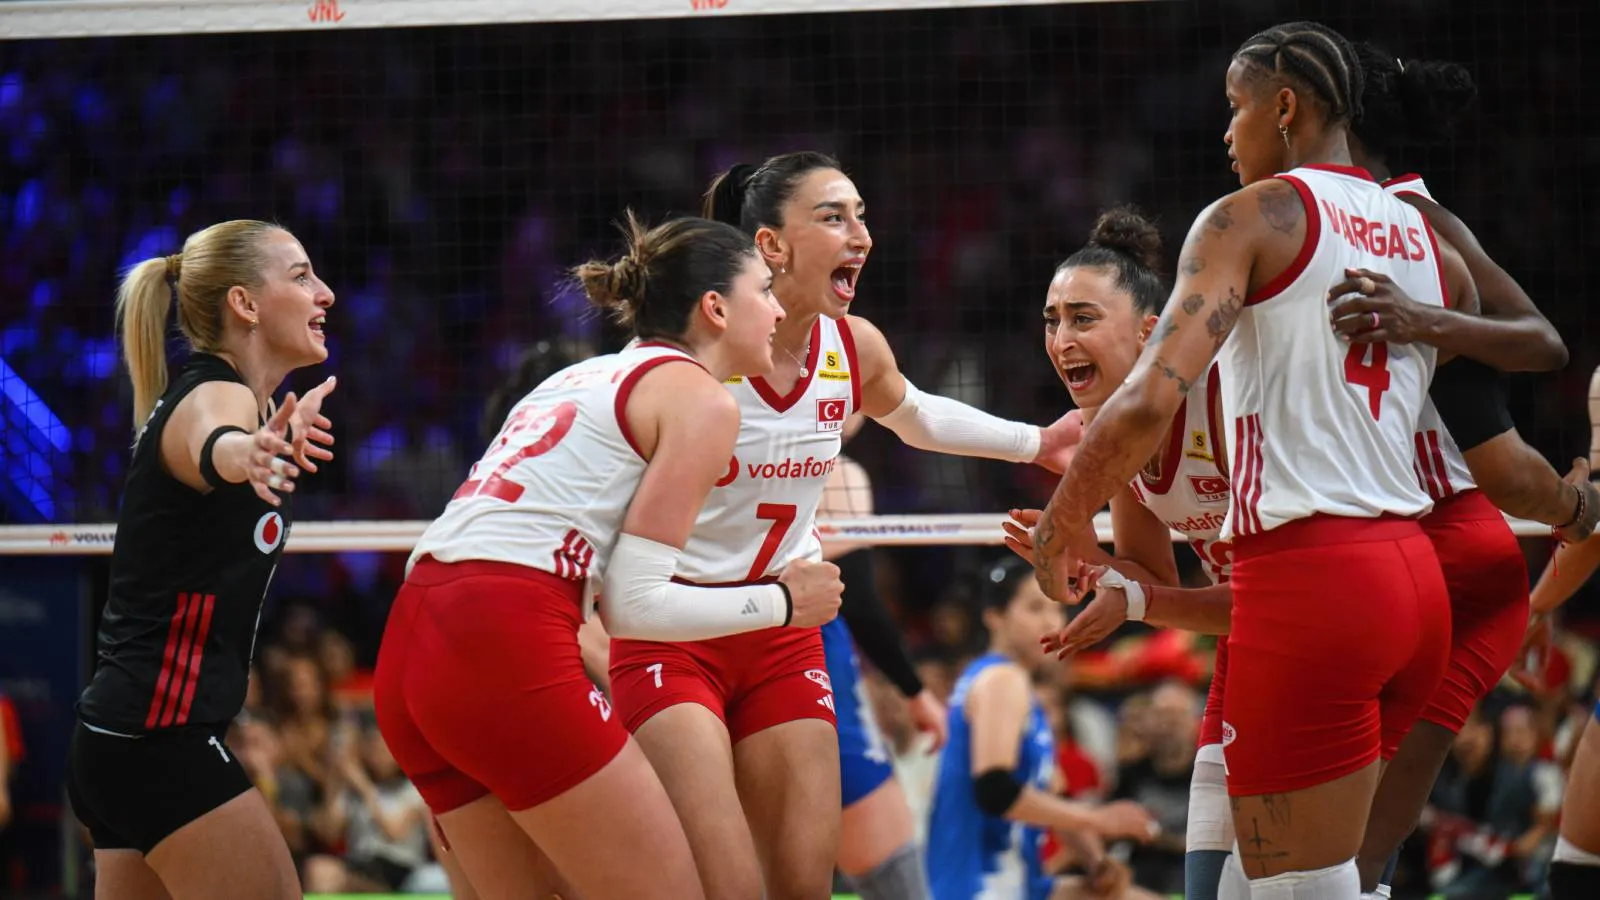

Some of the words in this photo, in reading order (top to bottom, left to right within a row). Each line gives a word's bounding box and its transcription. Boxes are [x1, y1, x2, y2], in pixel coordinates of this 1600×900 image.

[1321, 199, 1425, 261] VARGAS
[827, 355, 836, 367] S
[1344, 340, 1390, 421] 4
[1195, 434, 1204, 447] S
[842, 524, 932, 534] VOLLEYBALL
[744, 503, 797, 583] 7
[646, 663, 663, 688] 7
[208, 736, 230, 763] 1
